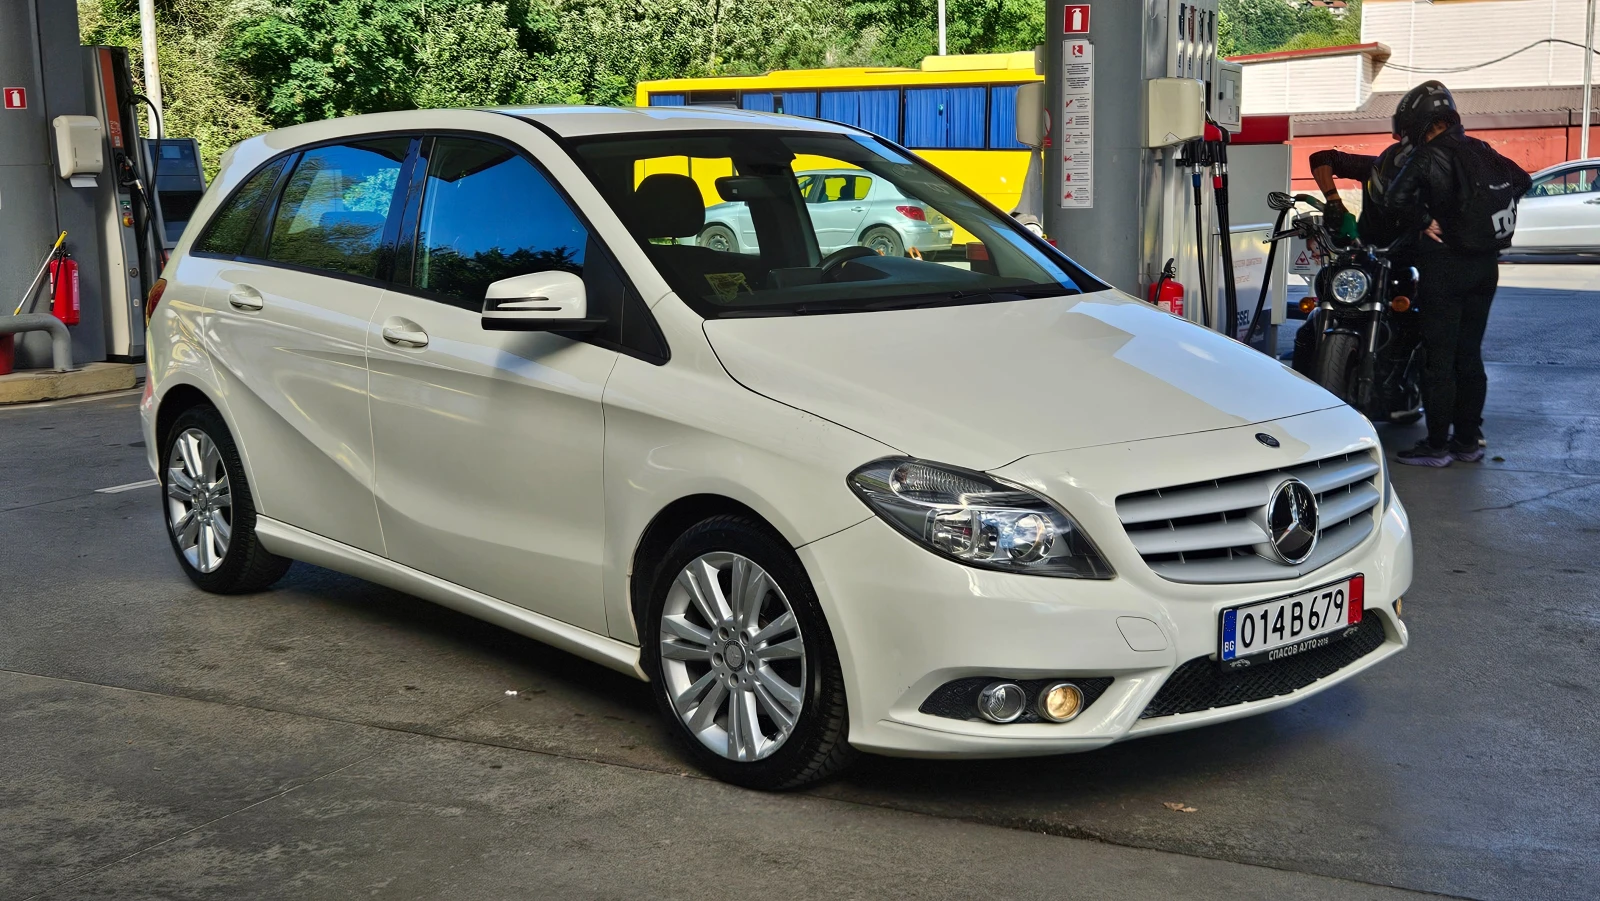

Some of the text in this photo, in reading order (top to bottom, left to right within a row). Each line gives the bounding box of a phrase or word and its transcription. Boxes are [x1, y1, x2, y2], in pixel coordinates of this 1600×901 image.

[1224, 641, 1235, 652] BG
[1268, 645, 1298, 661] СПАСОВ
[1299, 638, 1317, 653] АУТО
